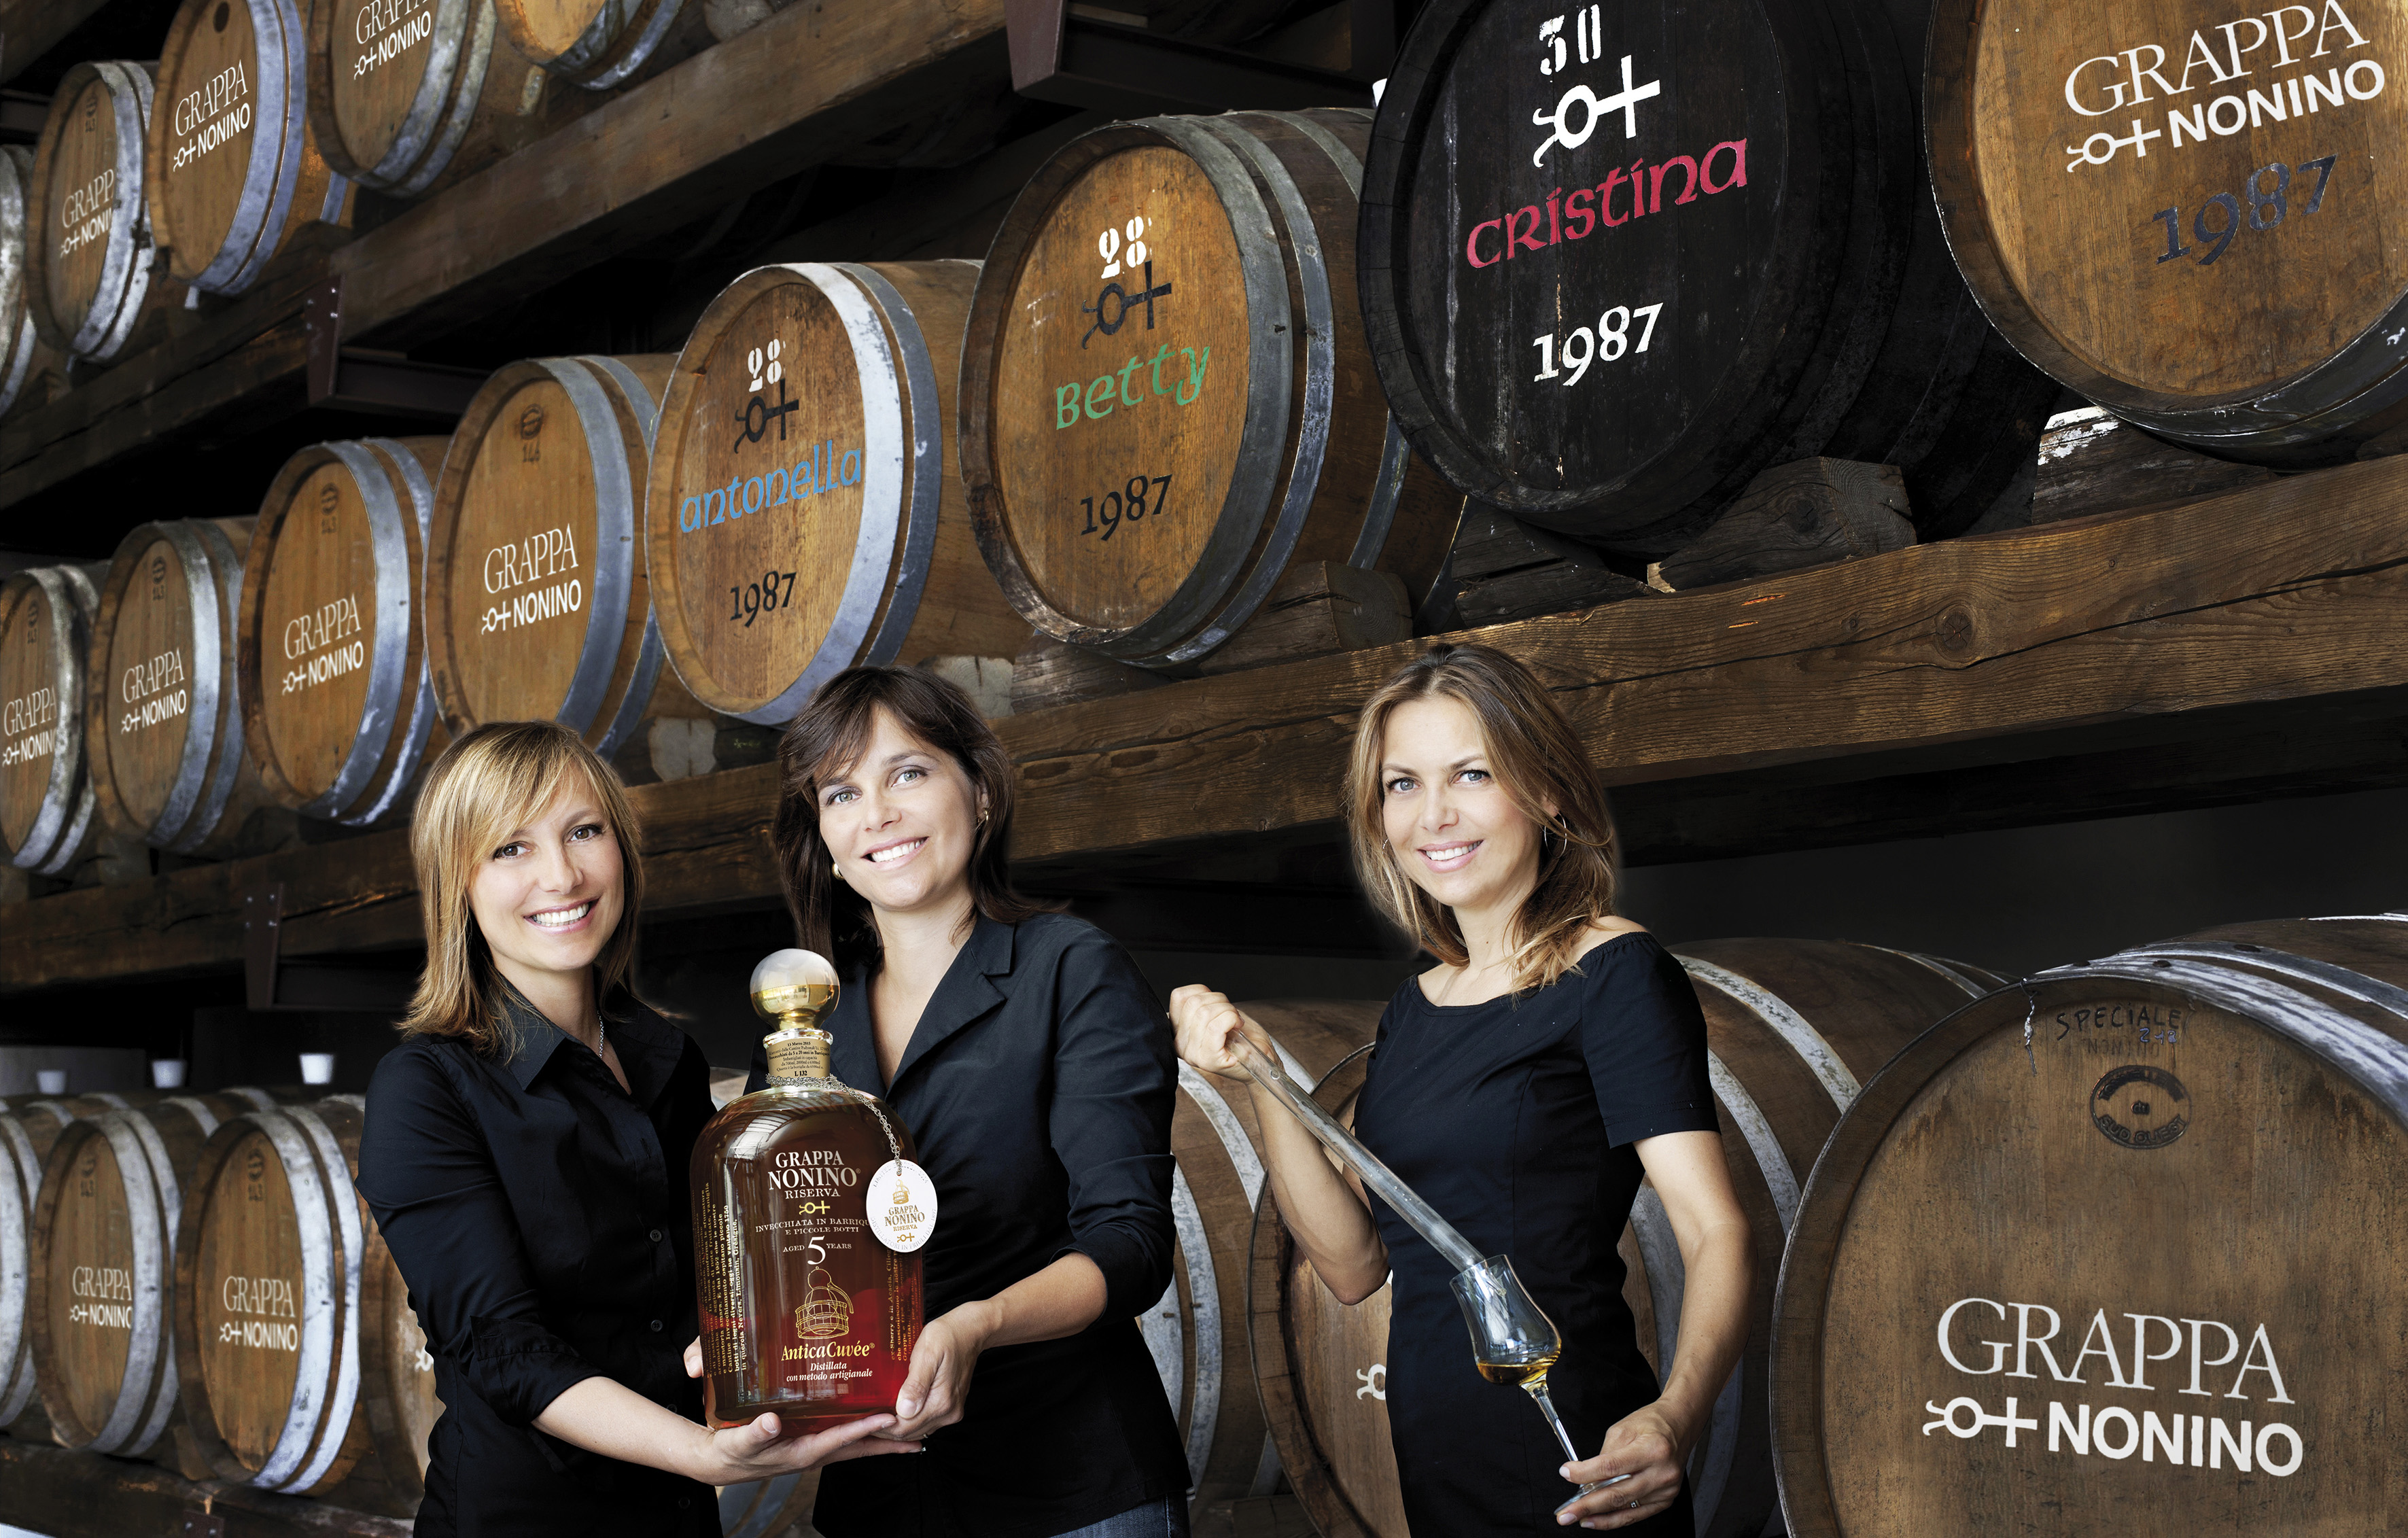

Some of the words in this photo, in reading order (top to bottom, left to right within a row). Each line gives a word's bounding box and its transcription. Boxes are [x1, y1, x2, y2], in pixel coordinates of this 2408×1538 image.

[379, 11, 431, 65] NONINO
[2064, 0, 2370, 116] GRAPPA
[175, 59, 248, 136] GRAPPA
[2167, 58, 2385, 148] NONINO
[198, 103, 250, 158] NONINO
[62, 169, 114, 228] GRAPP
[2150, 153, 2337, 266] 1987
[81, 207, 112, 246] NONI
[1098, 215, 1148, 279] 28
[747, 338, 782, 393] 28
[1533, 302, 1664, 387] 1987
[1055, 343, 1210, 430] Betty
[680, 438, 862, 534] antonella
[1080, 474, 1172, 541] 1987
[485, 523, 578, 593] GRAPPA
[514, 579, 581, 627] NONINO
[729, 570, 797, 628] 1987
[284, 593, 361, 660] GRAPPA
[123, 647, 185, 703] GRAPPA
[308, 641, 364, 687] NONINO
[3, 684, 57, 736] GRAPPA
[142, 688, 186, 729] NONINO
[2099, 1114, 2131, 1140] SUD
[2134, 1114, 2186, 1143] OUEST
[775, 1150, 844, 1168] GRAPPA
[785, 1189, 841, 1199] RISERVA
[884, 1212, 925, 1226] NONINO
[888, 1204, 919, 1215] GRAPPA
[756, 1219, 814, 1232] INVECCHIATA
[807, 1236, 826, 1265] 5
[73, 1266, 132, 1301] GRAPPA
[728, 1258, 732, 1267] ne
[224, 1276, 296, 1318] GRAPPA
[243, 1322, 298, 1352] NONINO
[738, 1331, 746, 1359] quercia
[1936, 1297, 2295, 1405] GRAPPA
[799, 1372, 827, 1381] metodo
[830, 1369, 873, 1380] artigianale
[810, 1361, 847, 1371] Distillata
[2047, 1400, 2304, 1478] NONINO
